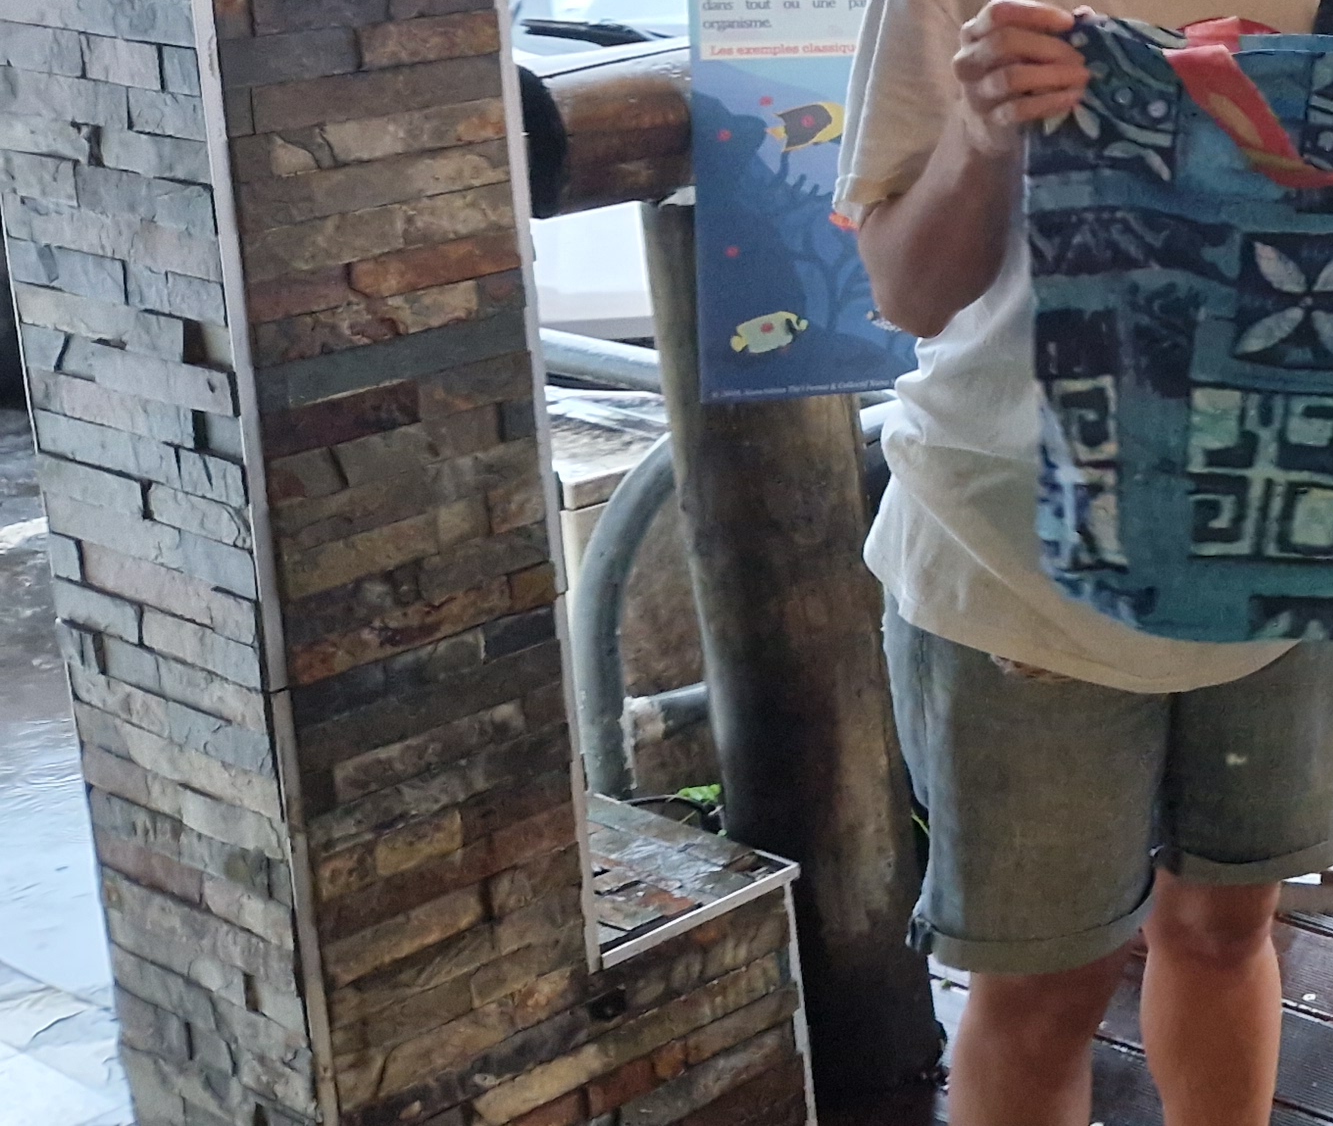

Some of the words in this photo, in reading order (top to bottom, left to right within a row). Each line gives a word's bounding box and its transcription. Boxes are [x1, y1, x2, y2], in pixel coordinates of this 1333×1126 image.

[702, 0, 734, 12] dans
[745, 0, 772, 11] tout
[783, 0, 800, 10] ou
[812, 0, 836, 10] une
[710, 45, 734, 56] Les
[736, 42, 800, 57] exemples
